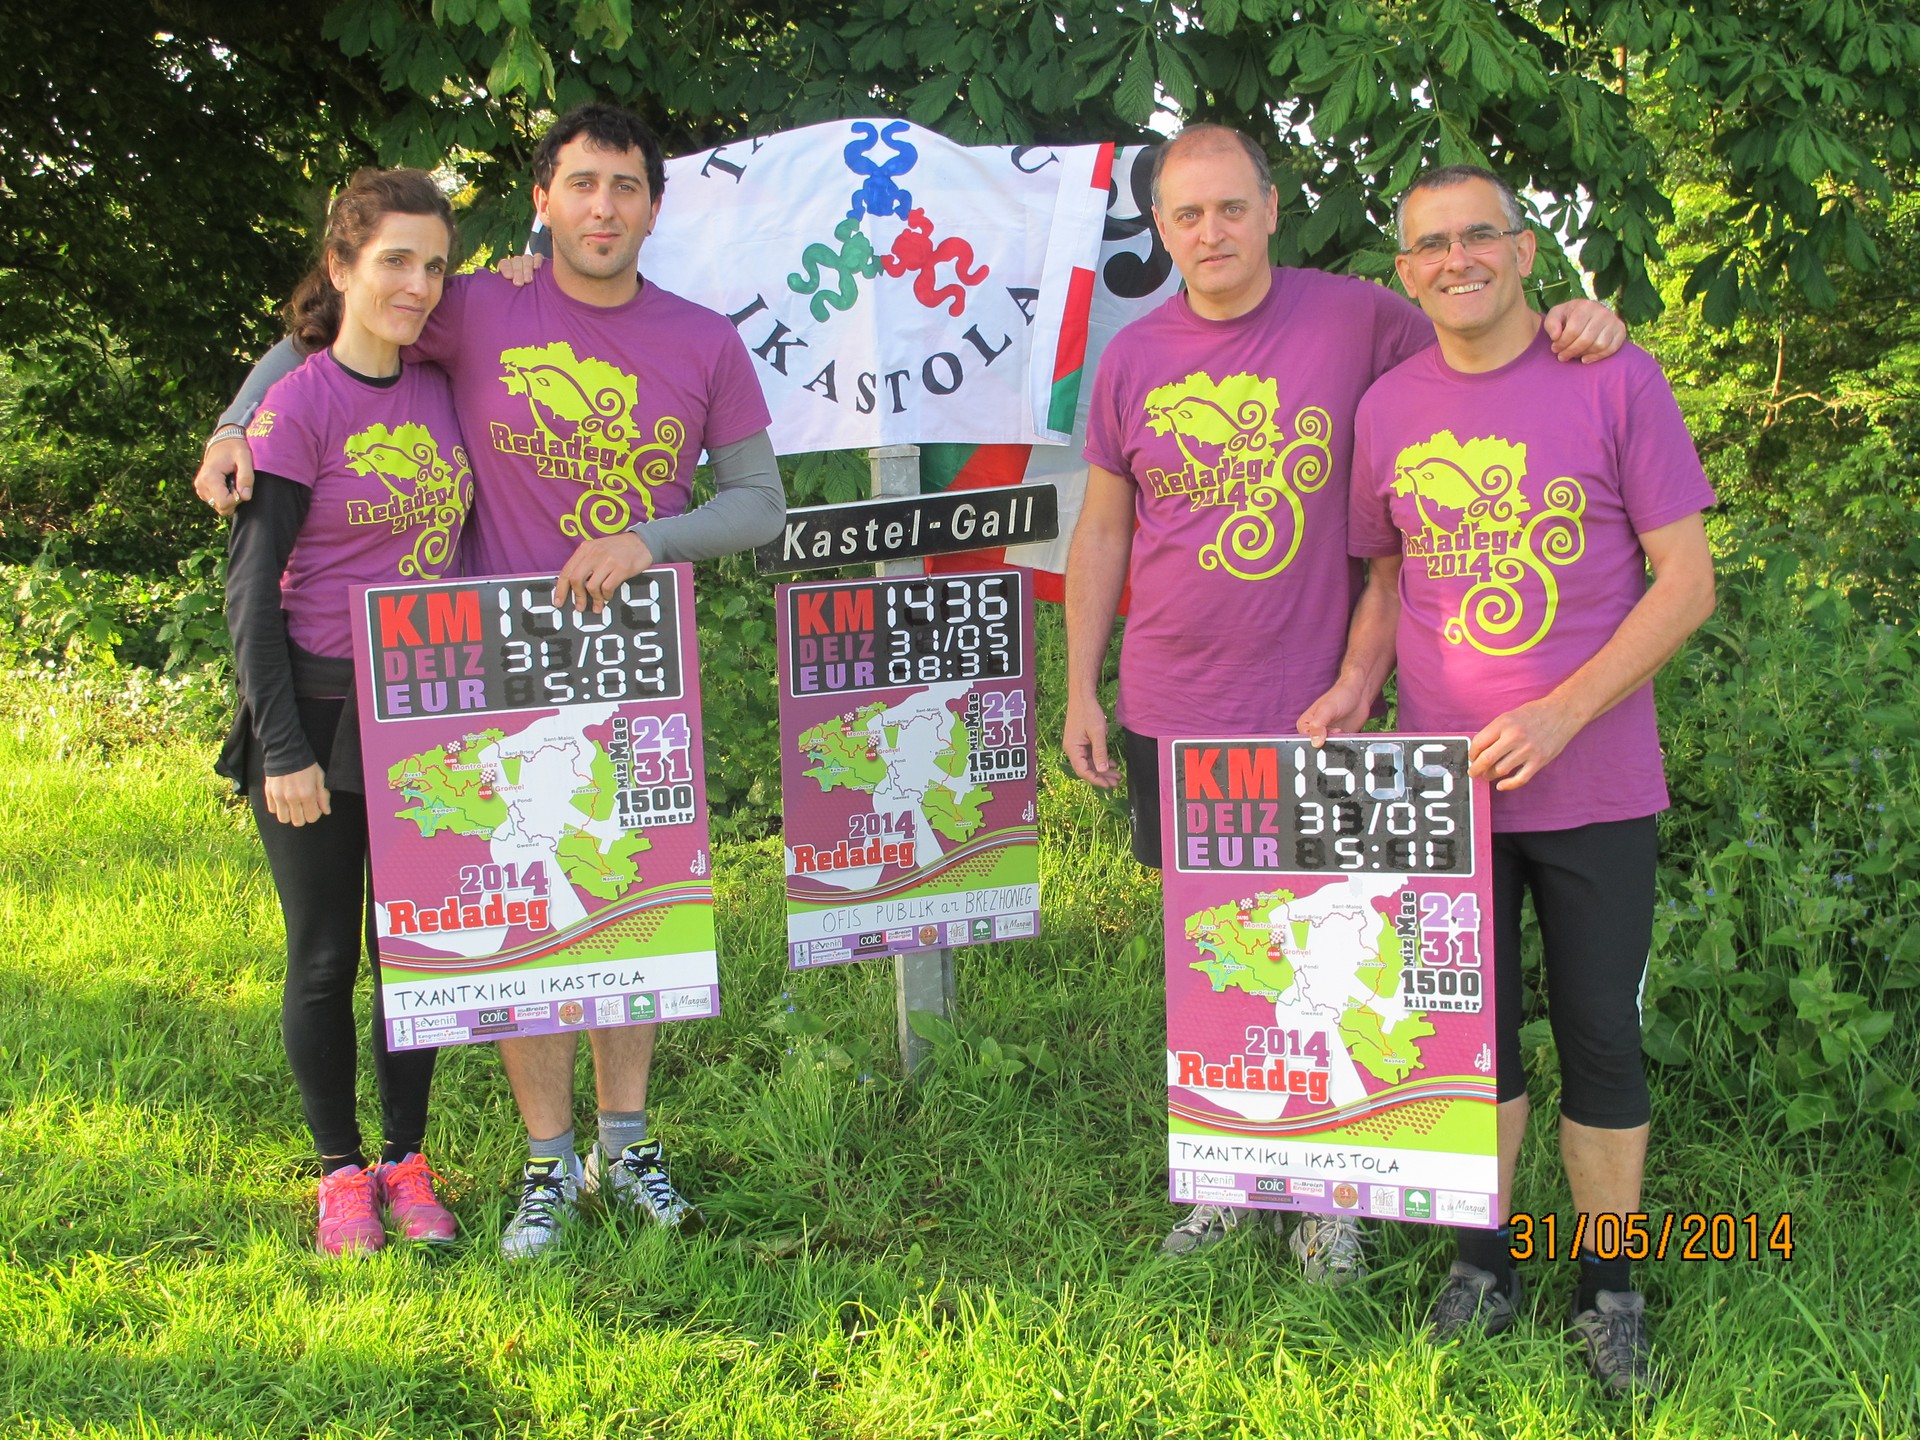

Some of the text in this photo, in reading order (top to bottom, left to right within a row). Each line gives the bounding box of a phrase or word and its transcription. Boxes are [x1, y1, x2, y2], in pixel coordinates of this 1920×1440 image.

[727, 286, 1039, 414] IKASTOLA
[490, 422, 617, 471] Redadeg
[537, 457, 604, 491] 2014
[1146, 457, 1263, 498] Redadeg
[347, 486, 447, 525] Redadeg
[783, 496, 1033, 561] Kastel-Gall
[1427, 551, 1493, 582] 2014
[378, 590, 483, 648] KM
[797, 578, 1008, 637] KM 1436
[384, 631, 664, 682] DEIZ 31/05
[800, 622, 1009, 664] DEIZ 31/05
[800, 650, 1009, 692] EUR 08:37
[386, 667, 665, 715] EUR 5:04
[983, 692, 1025, 719] 24
[965, 693, 980, 728] Mae
[609, 718, 629, 761] Mae
[634, 715, 689, 749] 24
[984, 718, 1026, 746] 31
[635, 748, 690, 782] 31
[968, 748, 1026, 772] 1500
[970, 769, 1026, 783] kilometr
[1184, 748, 1279, 800] KM
[615, 786, 692, 814] 1500
[619, 811, 693, 828] kilometr
[849, 810, 916, 839] 2014
[1187, 802, 1455, 836] DEIZ 31/05
[794, 837, 915, 874] Redadeg
[1187, 836, 1434, 869] EUR 5:11
[460, 860, 549, 896] 2014
[387, 893, 549, 936] Redadeg
[823, 909, 861, 933] OFIS
[876, 900, 934, 923] PUBLIK
[965, 886, 1032, 914] BREZHONEG
[1397, 892, 1416, 936] Mae
[1422, 895, 1478, 929] 24
[1423, 931, 1478, 965] 31
[394, 970, 646, 1011] TXANTXIKU IKASTOLA
[1400, 969, 1480, 997] 1500
[1403, 995, 1480, 1011] kilometr
[1246, 1027, 1331, 1068] 2014
[1178, 1052, 1329, 1103] Redadeg
[1176, 1141, 1400, 1174] TXANTXIKU IKASTOLA
